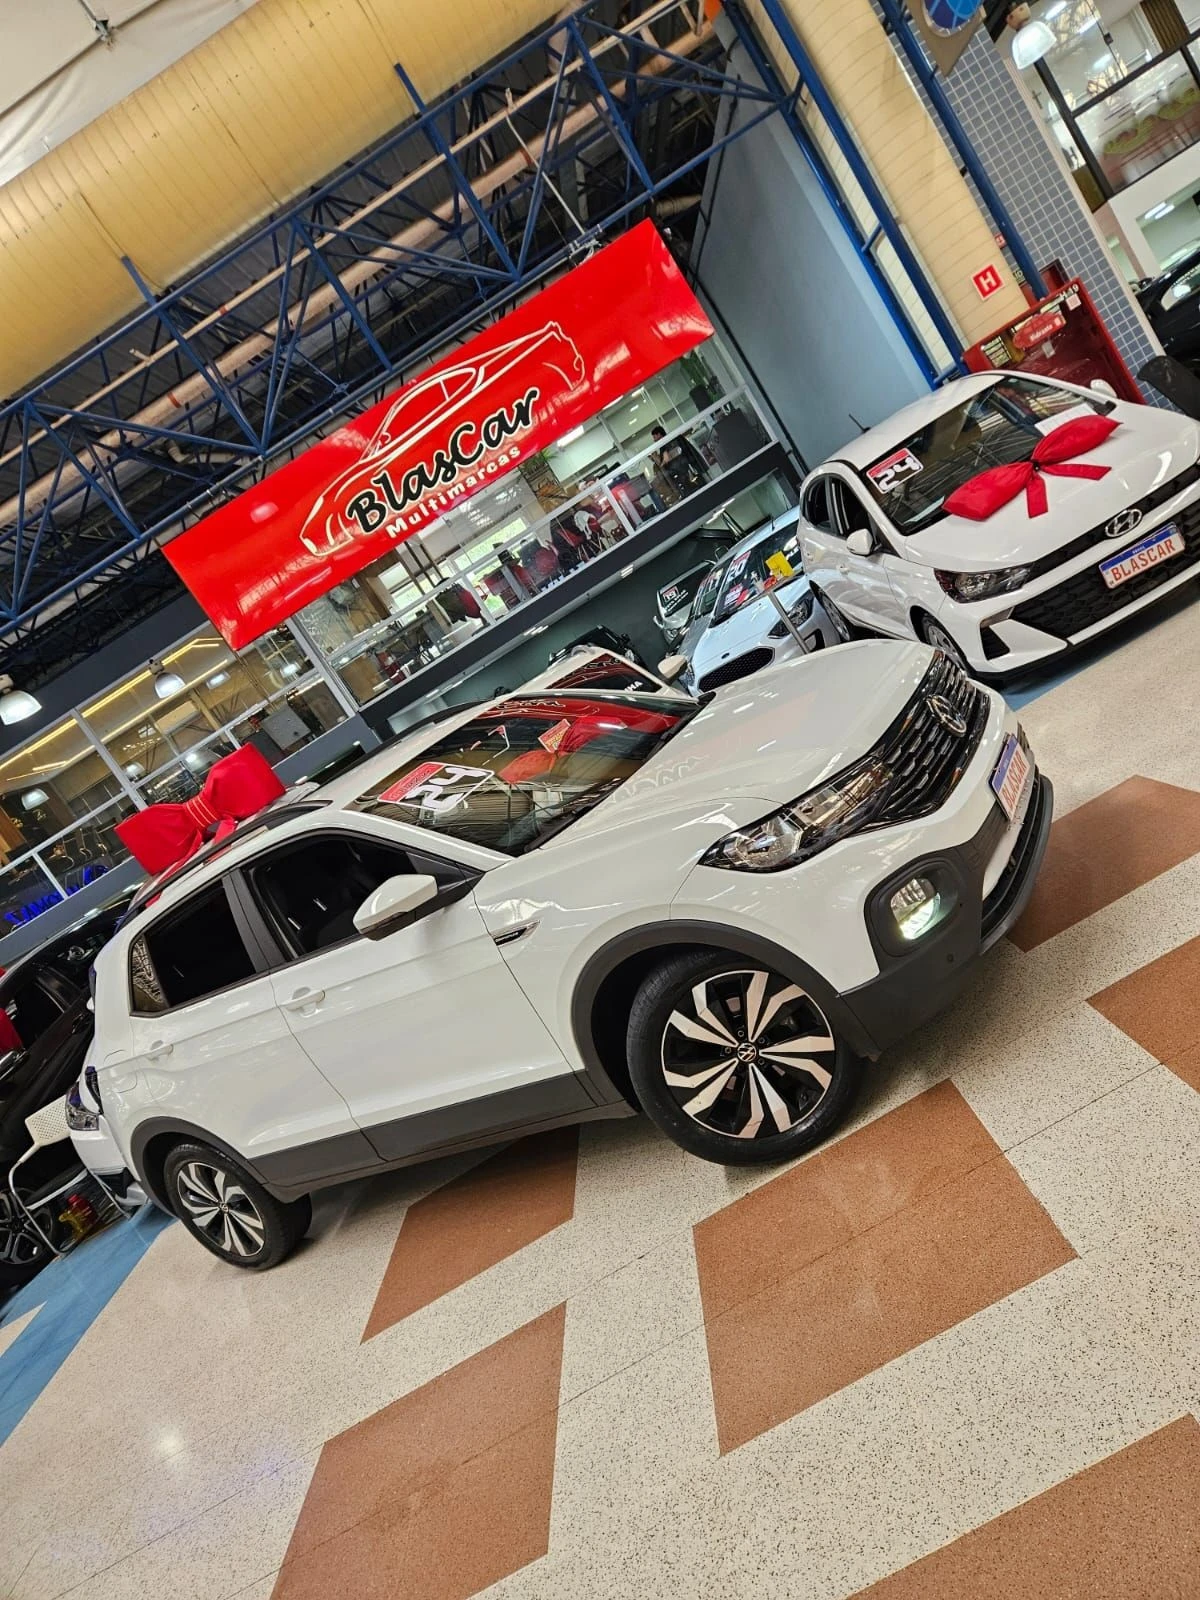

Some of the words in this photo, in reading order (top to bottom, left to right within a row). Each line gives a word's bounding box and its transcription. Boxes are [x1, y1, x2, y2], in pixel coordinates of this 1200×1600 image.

[979, 270, 997, 292] H
[346, 387, 539, 534] BlasCar
[874, 456, 920, 491] 24
[385, 446, 521, 539] Multimarcas
[1110, 538, 1176, 582] BLASCAR
[404, 766, 489, 811] 24
[1001, 749, 1028, 810] BLASCAR
